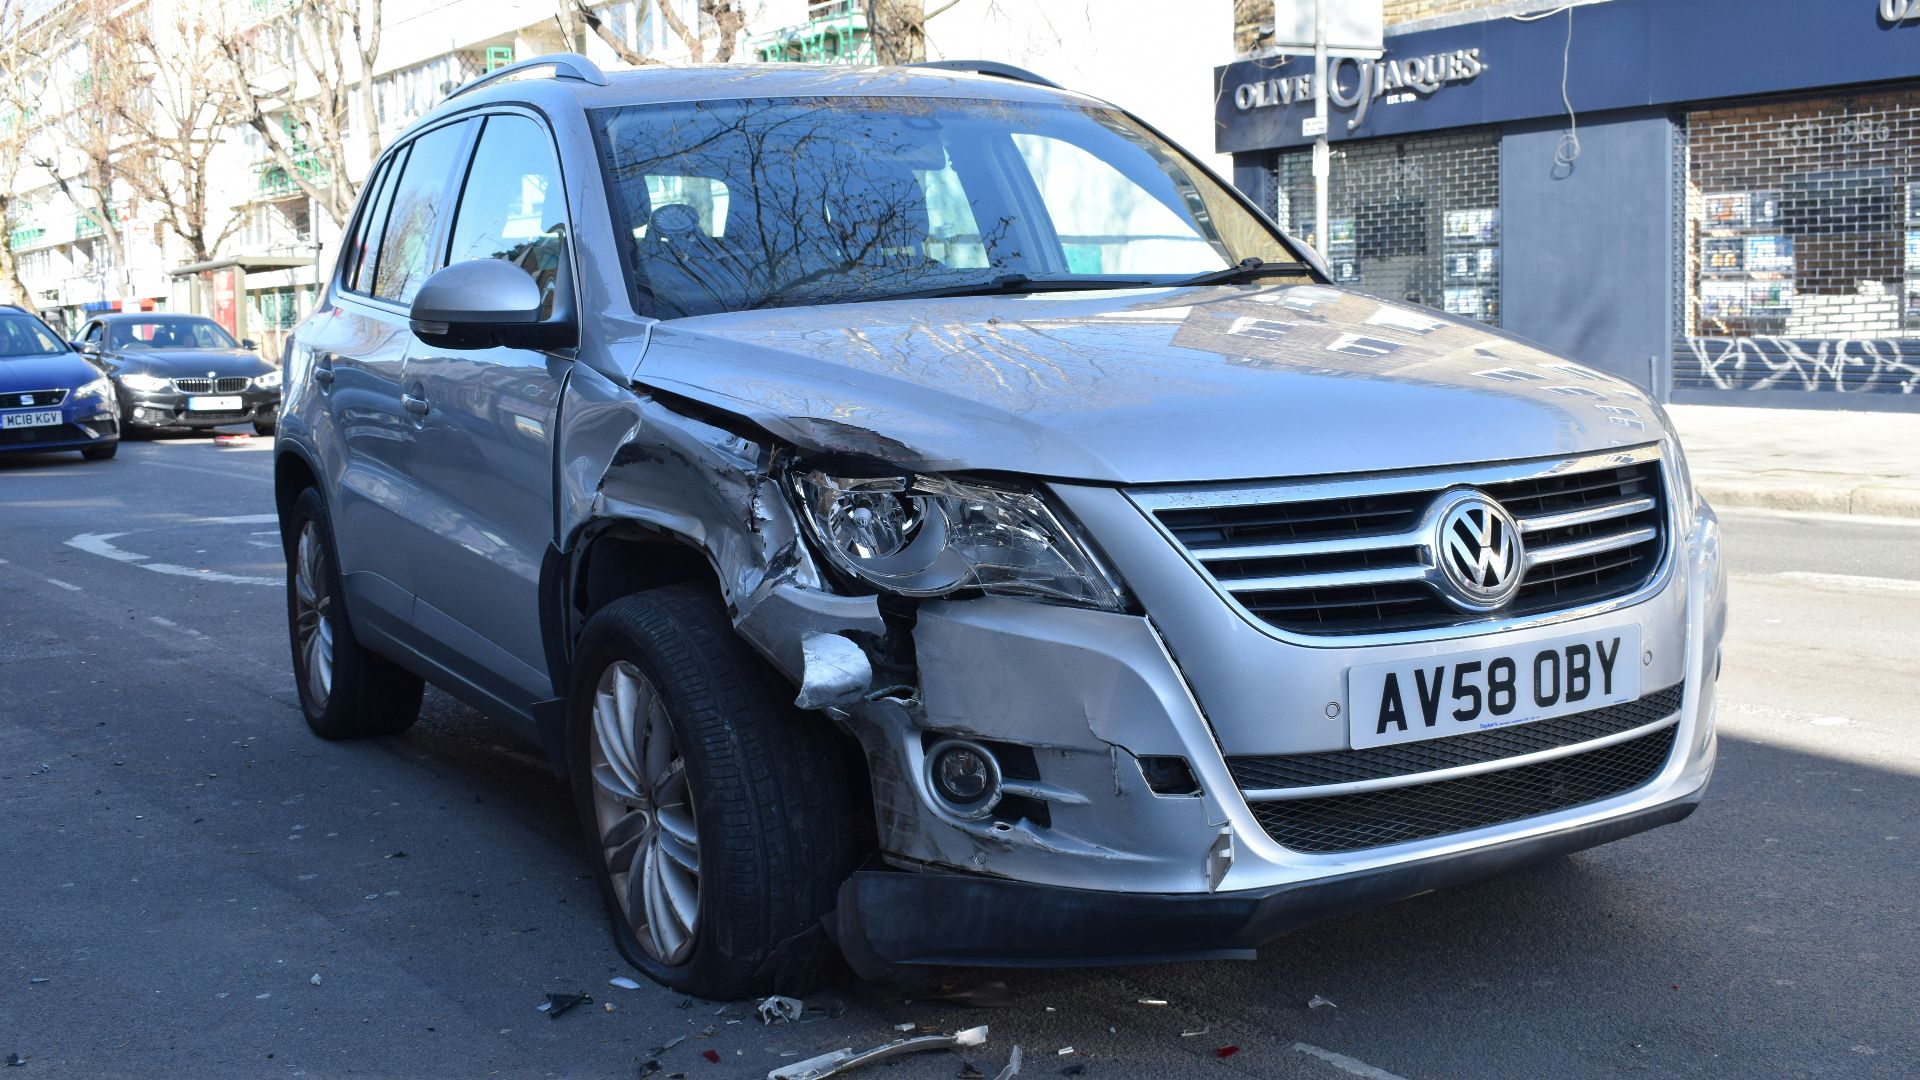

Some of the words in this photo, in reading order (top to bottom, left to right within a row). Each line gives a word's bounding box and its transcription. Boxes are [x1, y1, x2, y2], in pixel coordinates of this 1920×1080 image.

[1235, 73, 1316, 110] OLIVE
[1371, 48, 1481, 98] JAQUES
[6, 414, 33, 426] MC18
[36, 412, 57, 424] KGV
[1376, 656, 1516, 734] AV58
[1533, 636, 1621, 708] OBY
